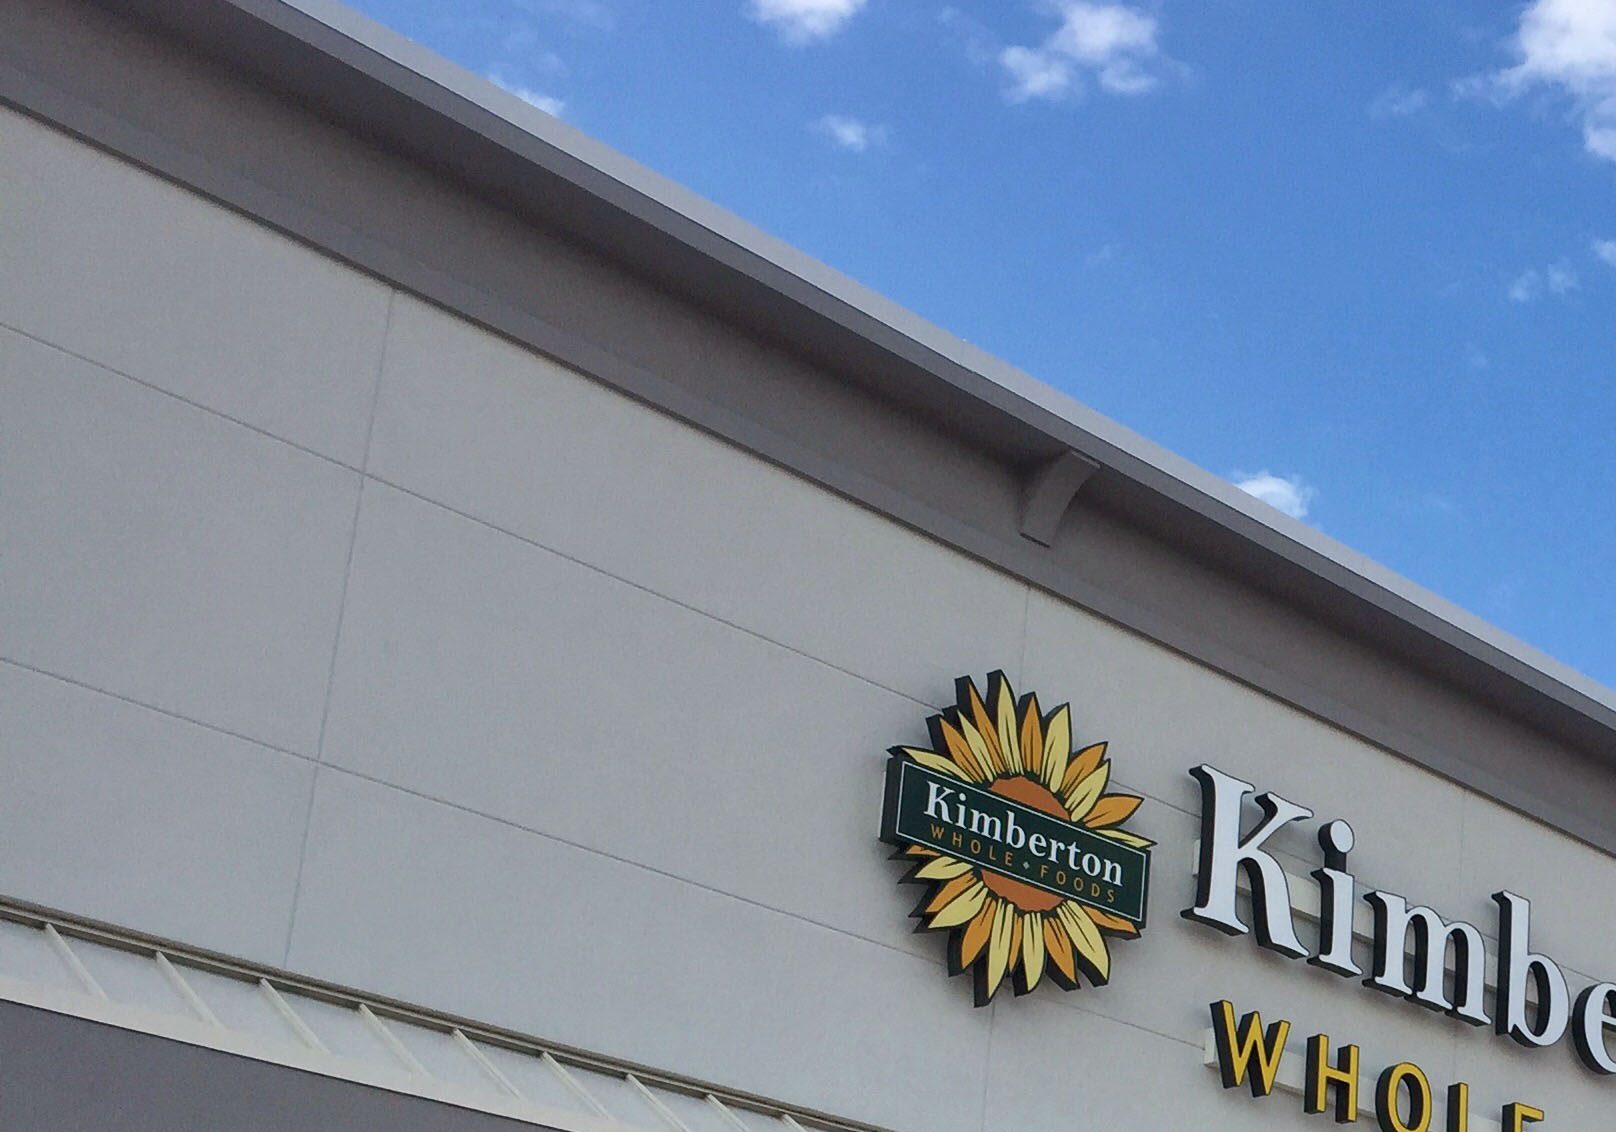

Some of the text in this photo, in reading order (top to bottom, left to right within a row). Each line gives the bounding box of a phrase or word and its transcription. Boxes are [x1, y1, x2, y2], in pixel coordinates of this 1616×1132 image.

[923, 780, 1123, 888] Kimberton
[931, 824, 1115, 904] WHOLE FOODS
